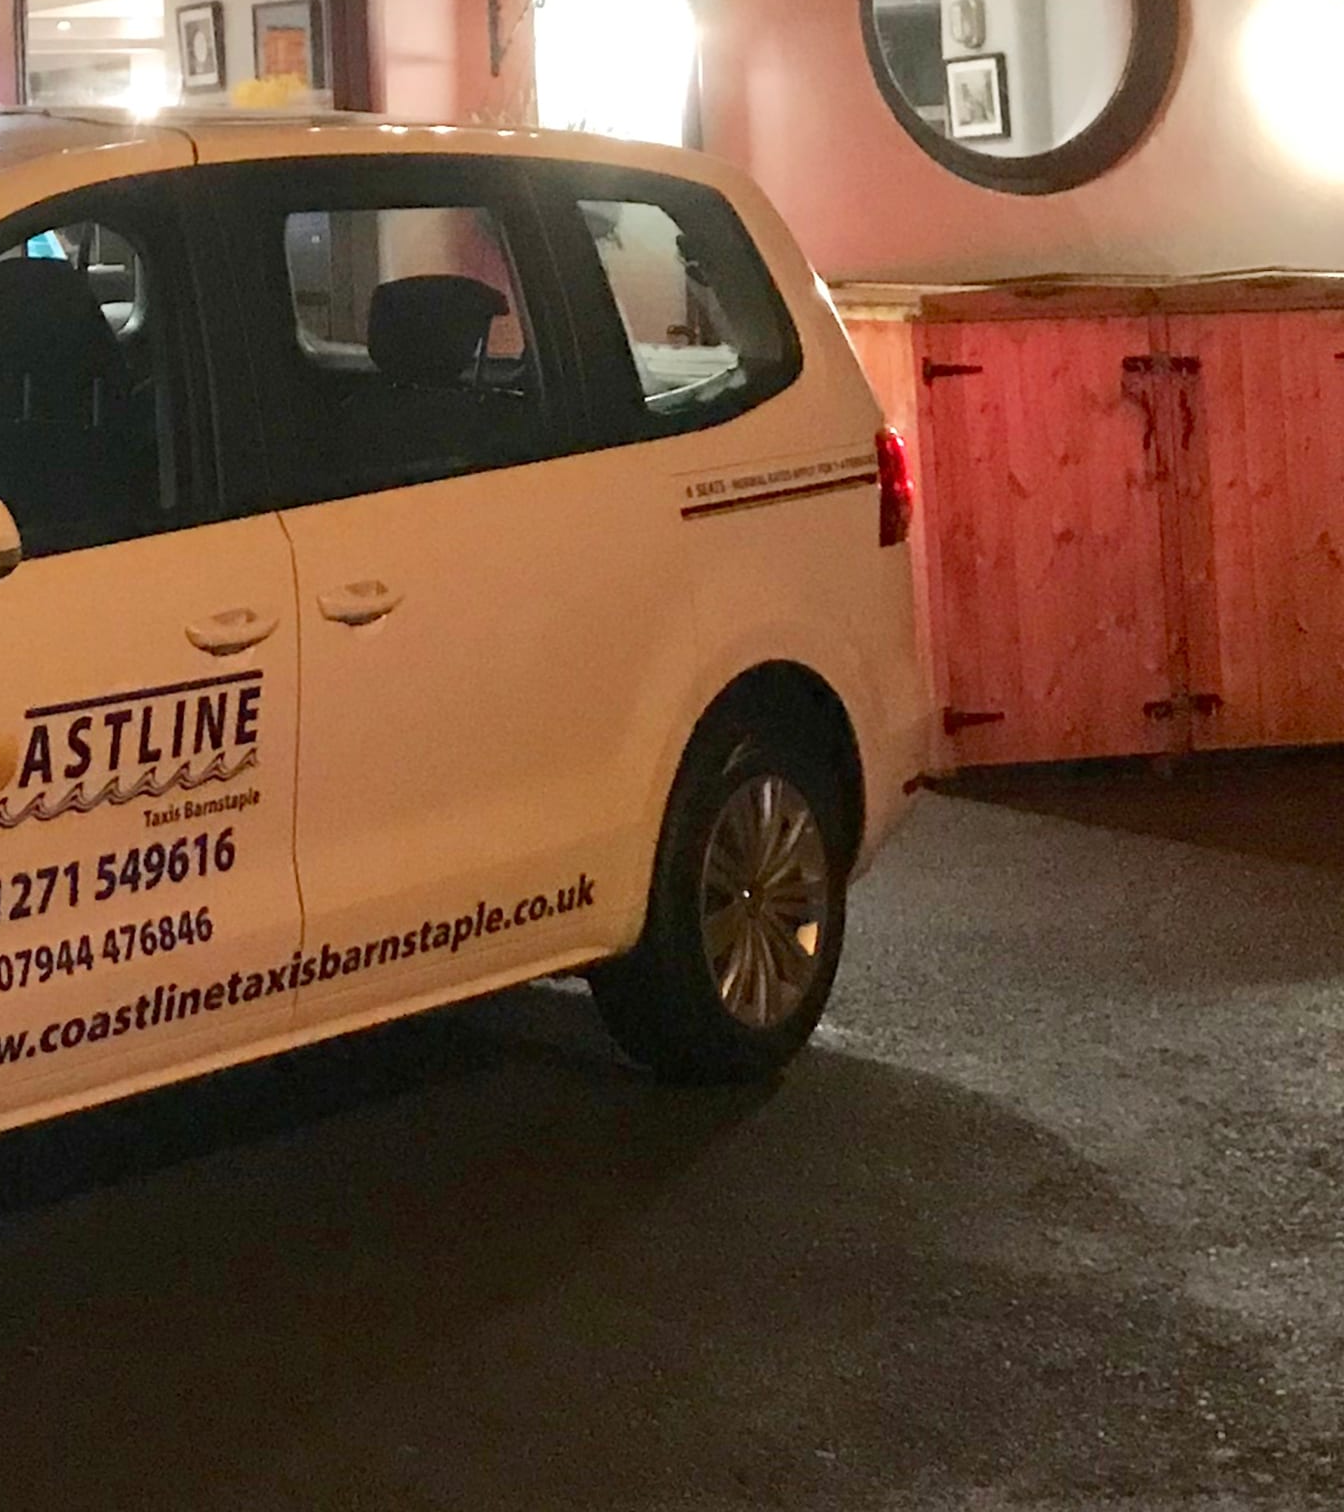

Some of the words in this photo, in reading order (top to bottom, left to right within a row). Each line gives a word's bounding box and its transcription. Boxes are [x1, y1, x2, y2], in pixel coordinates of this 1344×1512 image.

[143, 802, 182, 828] Taxis
[184, 787, 261, 821] Barnstaple
[94, 826, 236, 902] 549616
[101, 905, 214, 965] 476846
